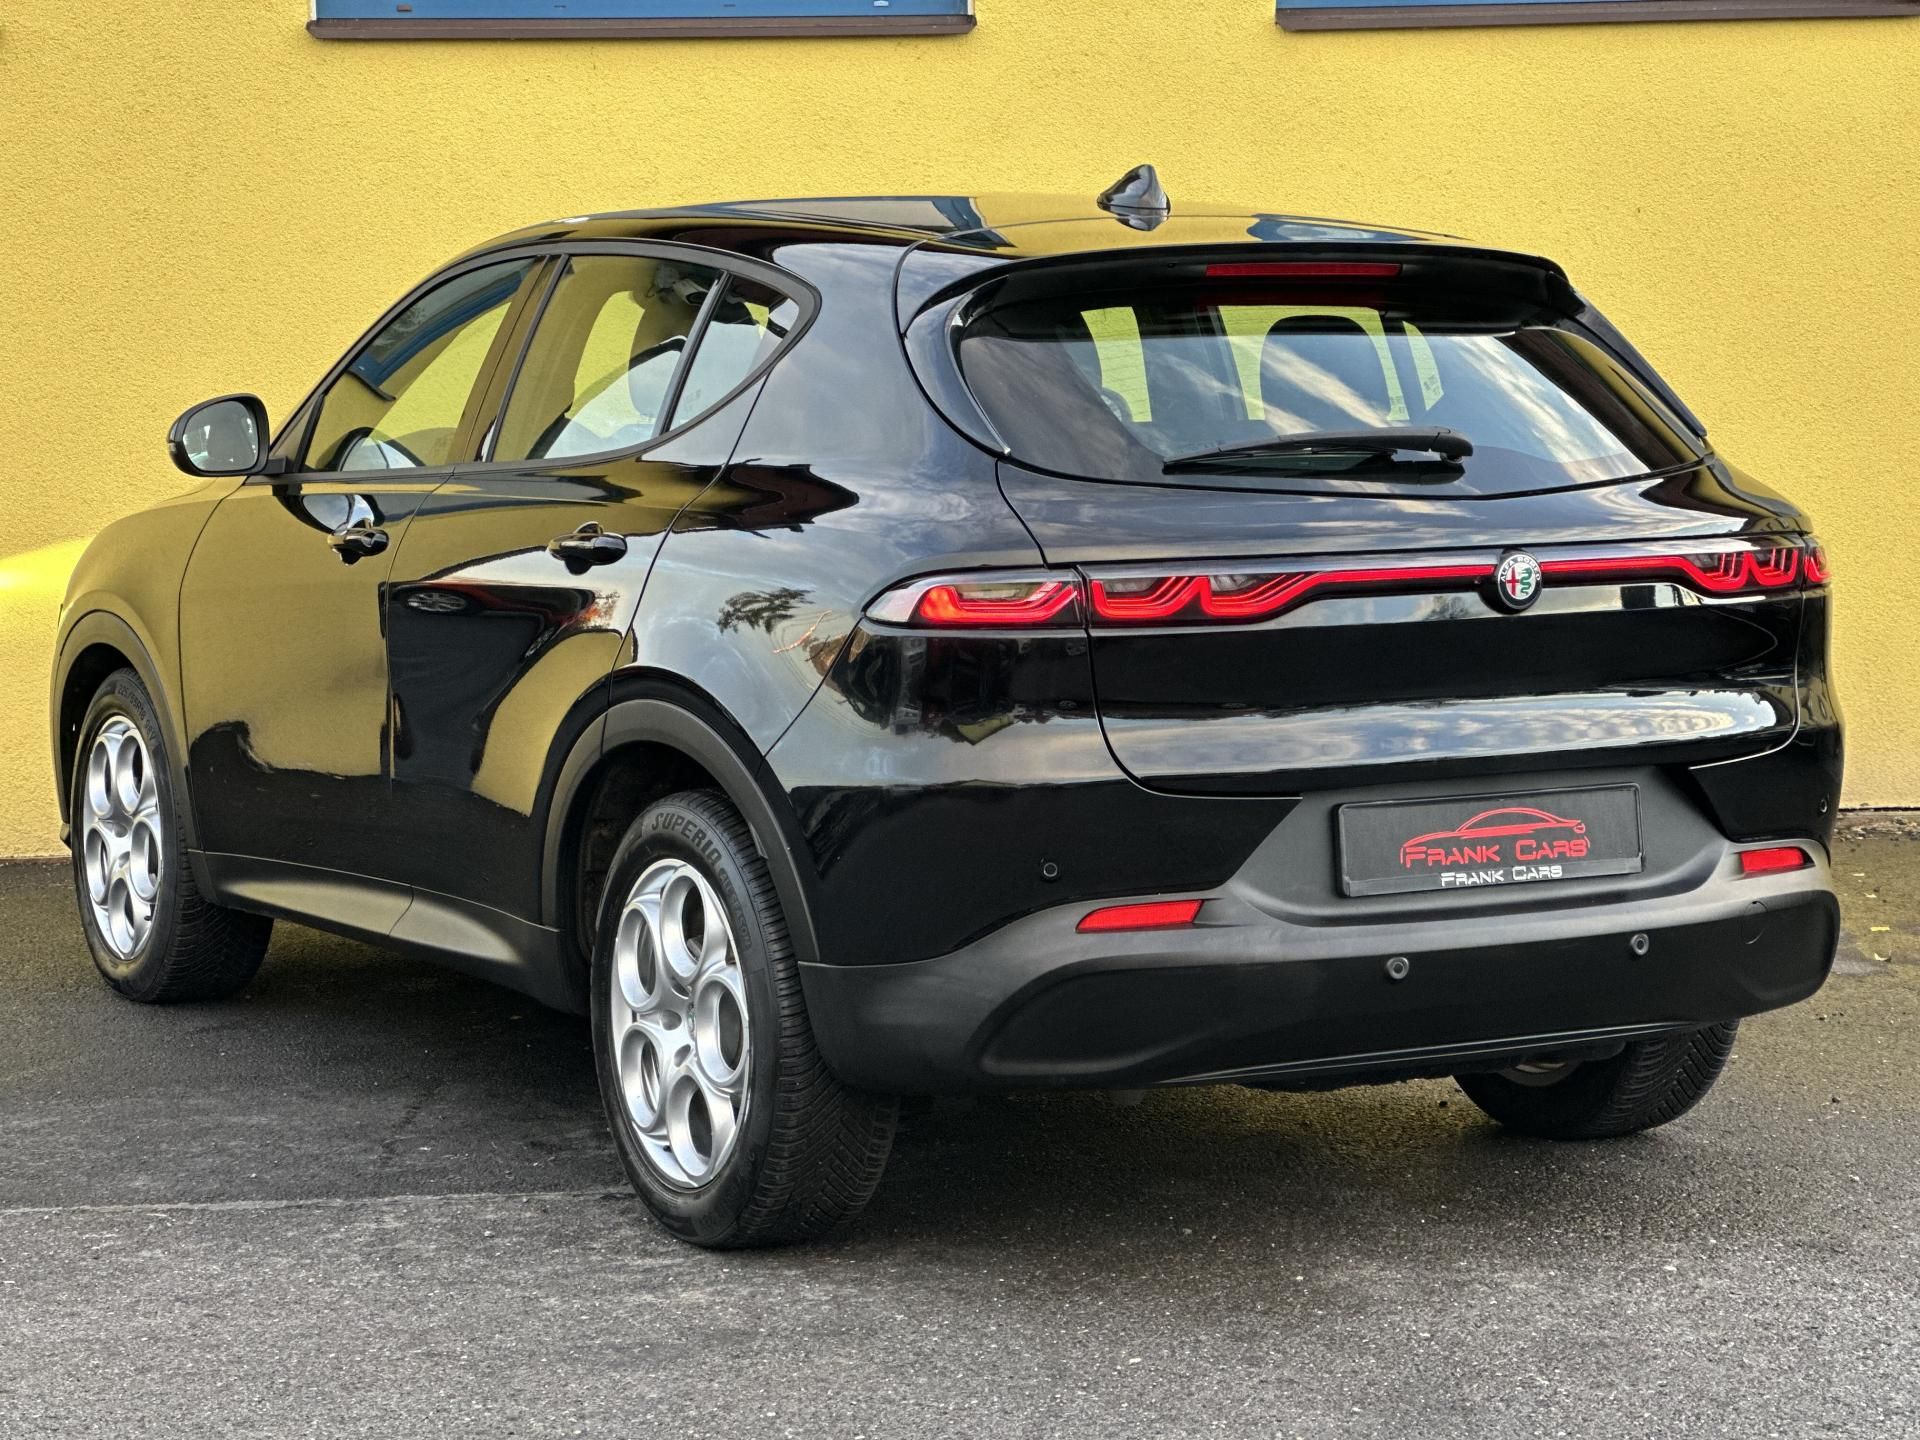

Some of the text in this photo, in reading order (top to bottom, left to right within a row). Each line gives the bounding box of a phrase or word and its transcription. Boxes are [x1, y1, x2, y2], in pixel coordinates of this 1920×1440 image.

[1501, 556, 1540, 582] ALFA ROMEO
[651, 812, 722, 865] SUPERIA
[1404, 839, 1587, 868] FRANK CARS
[1440, 865, 1563, 887] FRANK CARS
